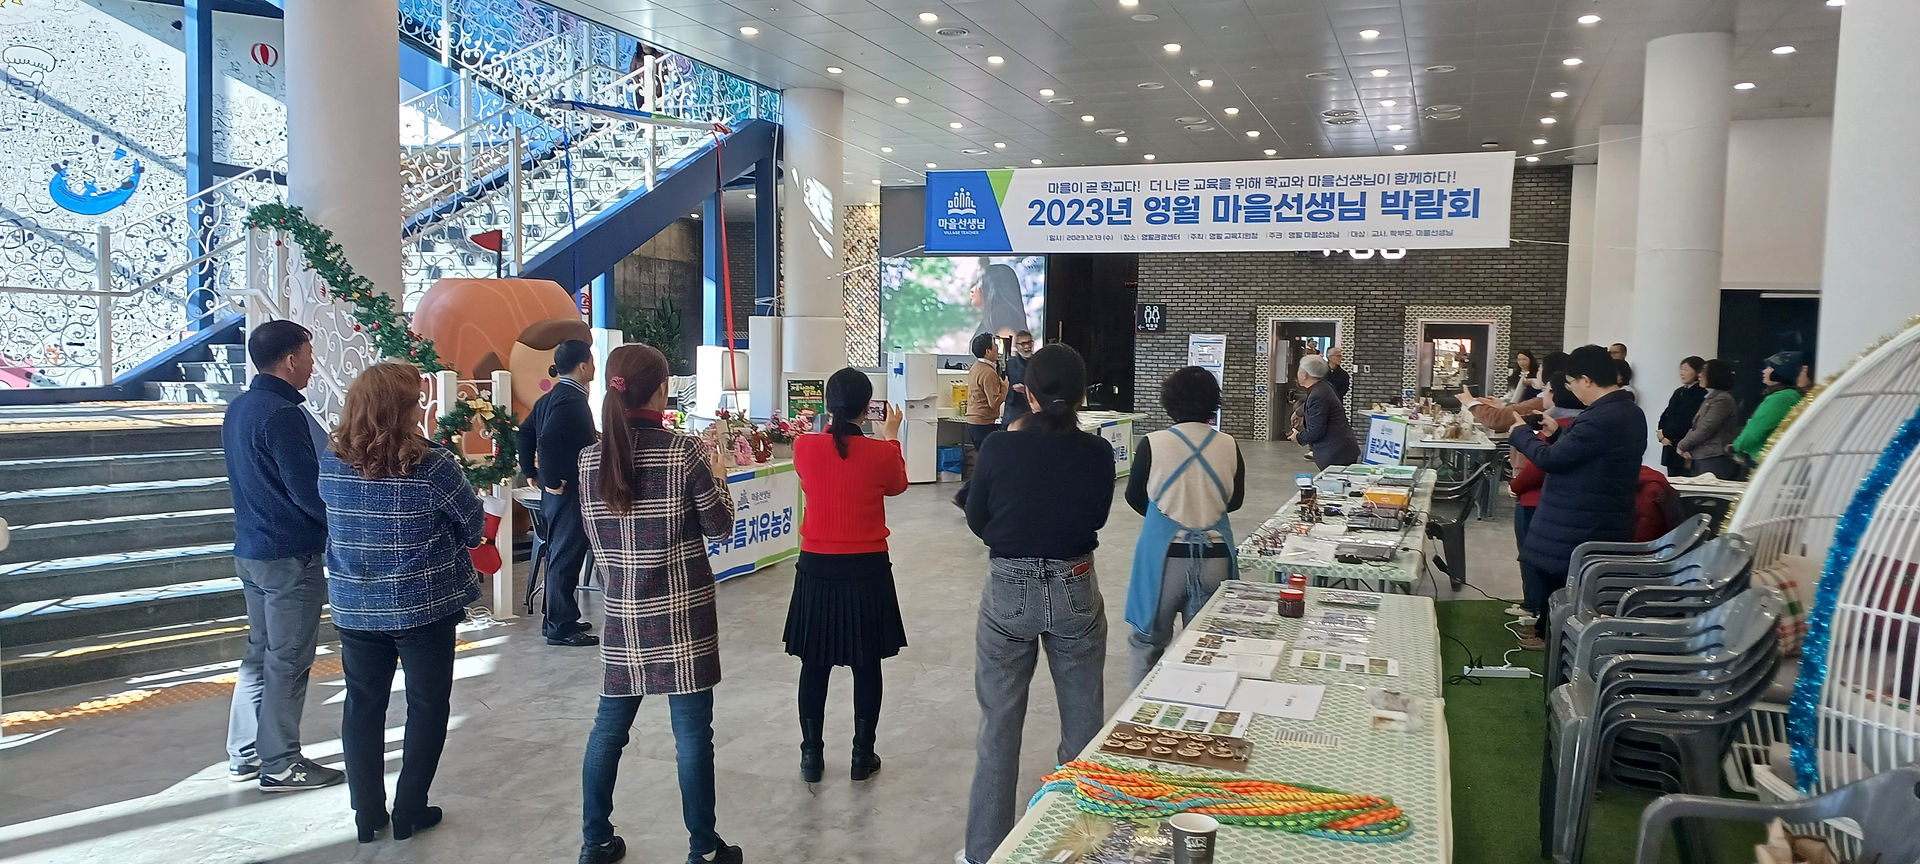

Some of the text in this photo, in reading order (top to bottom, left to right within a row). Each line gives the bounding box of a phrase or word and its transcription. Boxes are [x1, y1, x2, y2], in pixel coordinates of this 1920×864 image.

[1048, 170, 1457, 194] 마을이 곧 학교다! 더 나은 교육을 위해 학교와 마을선생님이 함께하다!
[1027, 188, 1481, 226] 2023년 영월 마을선생님 박람회
[938, 218, 986, 230] 마을선생님
